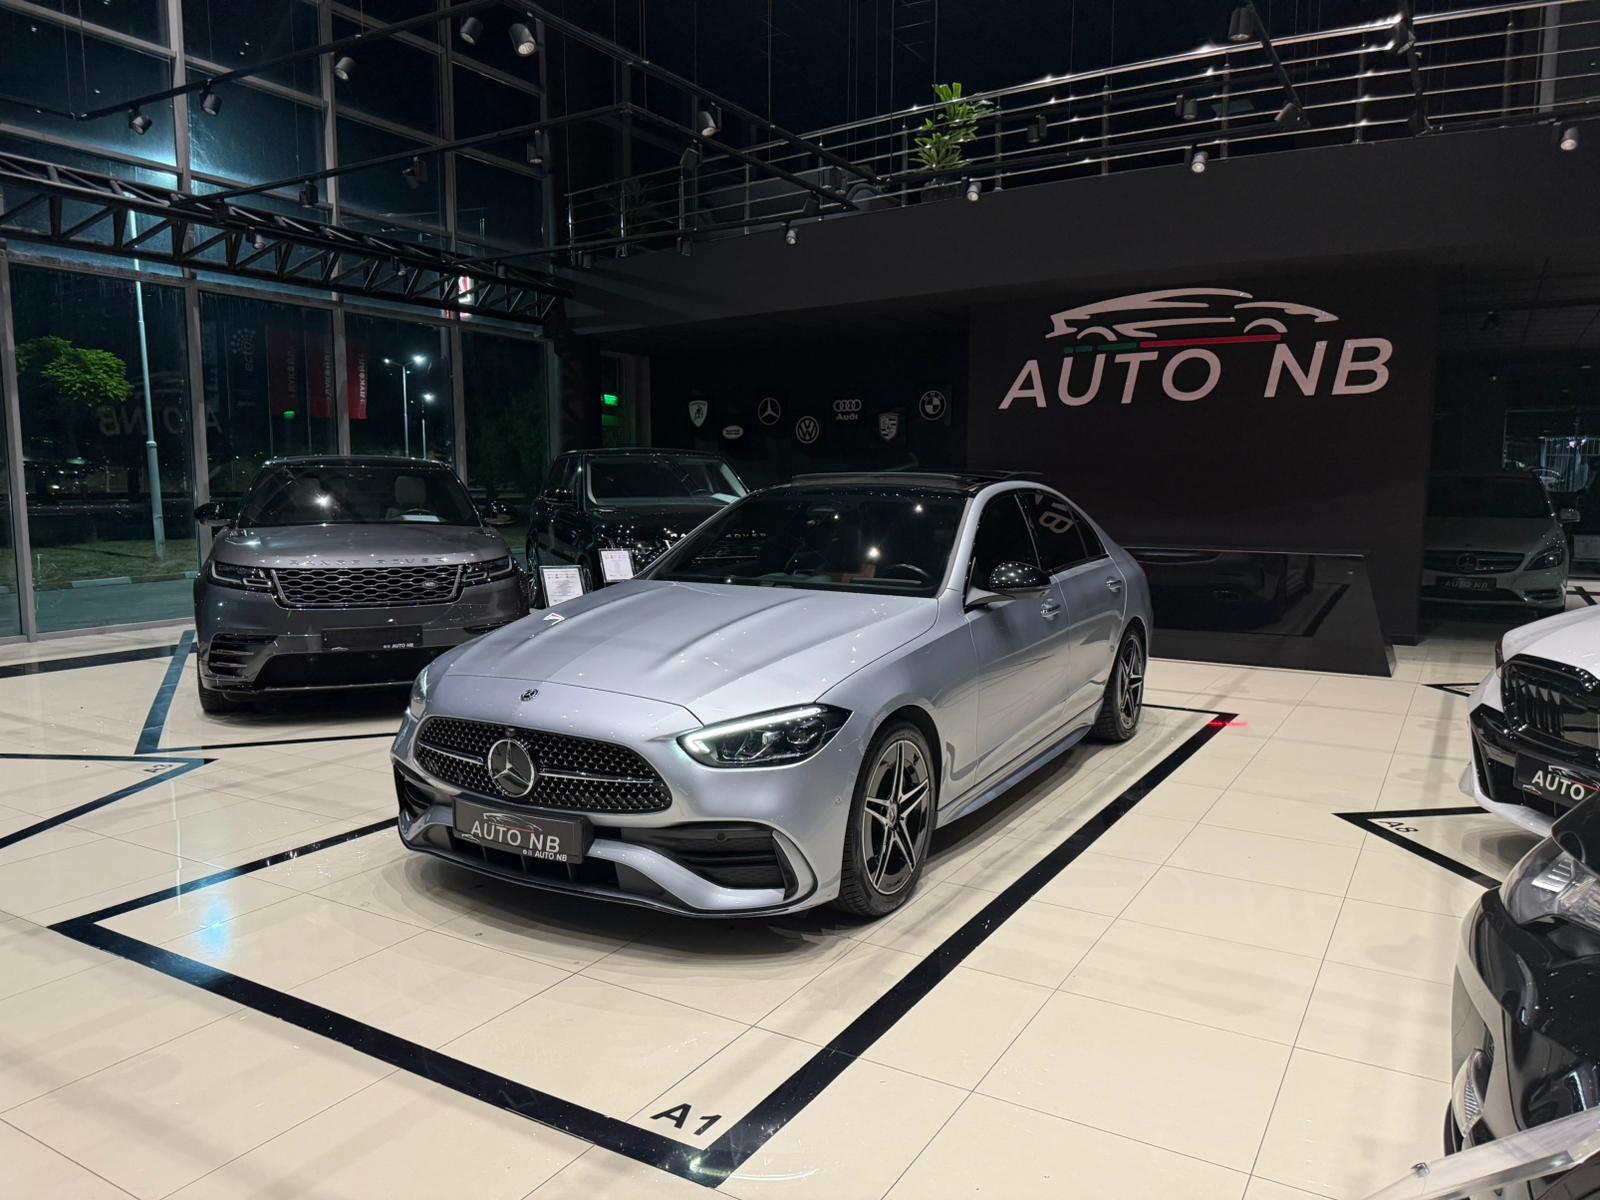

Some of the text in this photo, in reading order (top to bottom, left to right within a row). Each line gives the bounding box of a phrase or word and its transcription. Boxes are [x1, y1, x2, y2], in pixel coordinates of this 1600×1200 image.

[998, 338, 1393, 409] AUTO NB
[1532, 770, 1585, 800] AUTO
[471, 820, 560, 853] AUTO NB
[1378, 820, 1419, 832] A8
[535, 850, 568, 862] AUTO NB
[650, 1103, 722, 1136] A1
